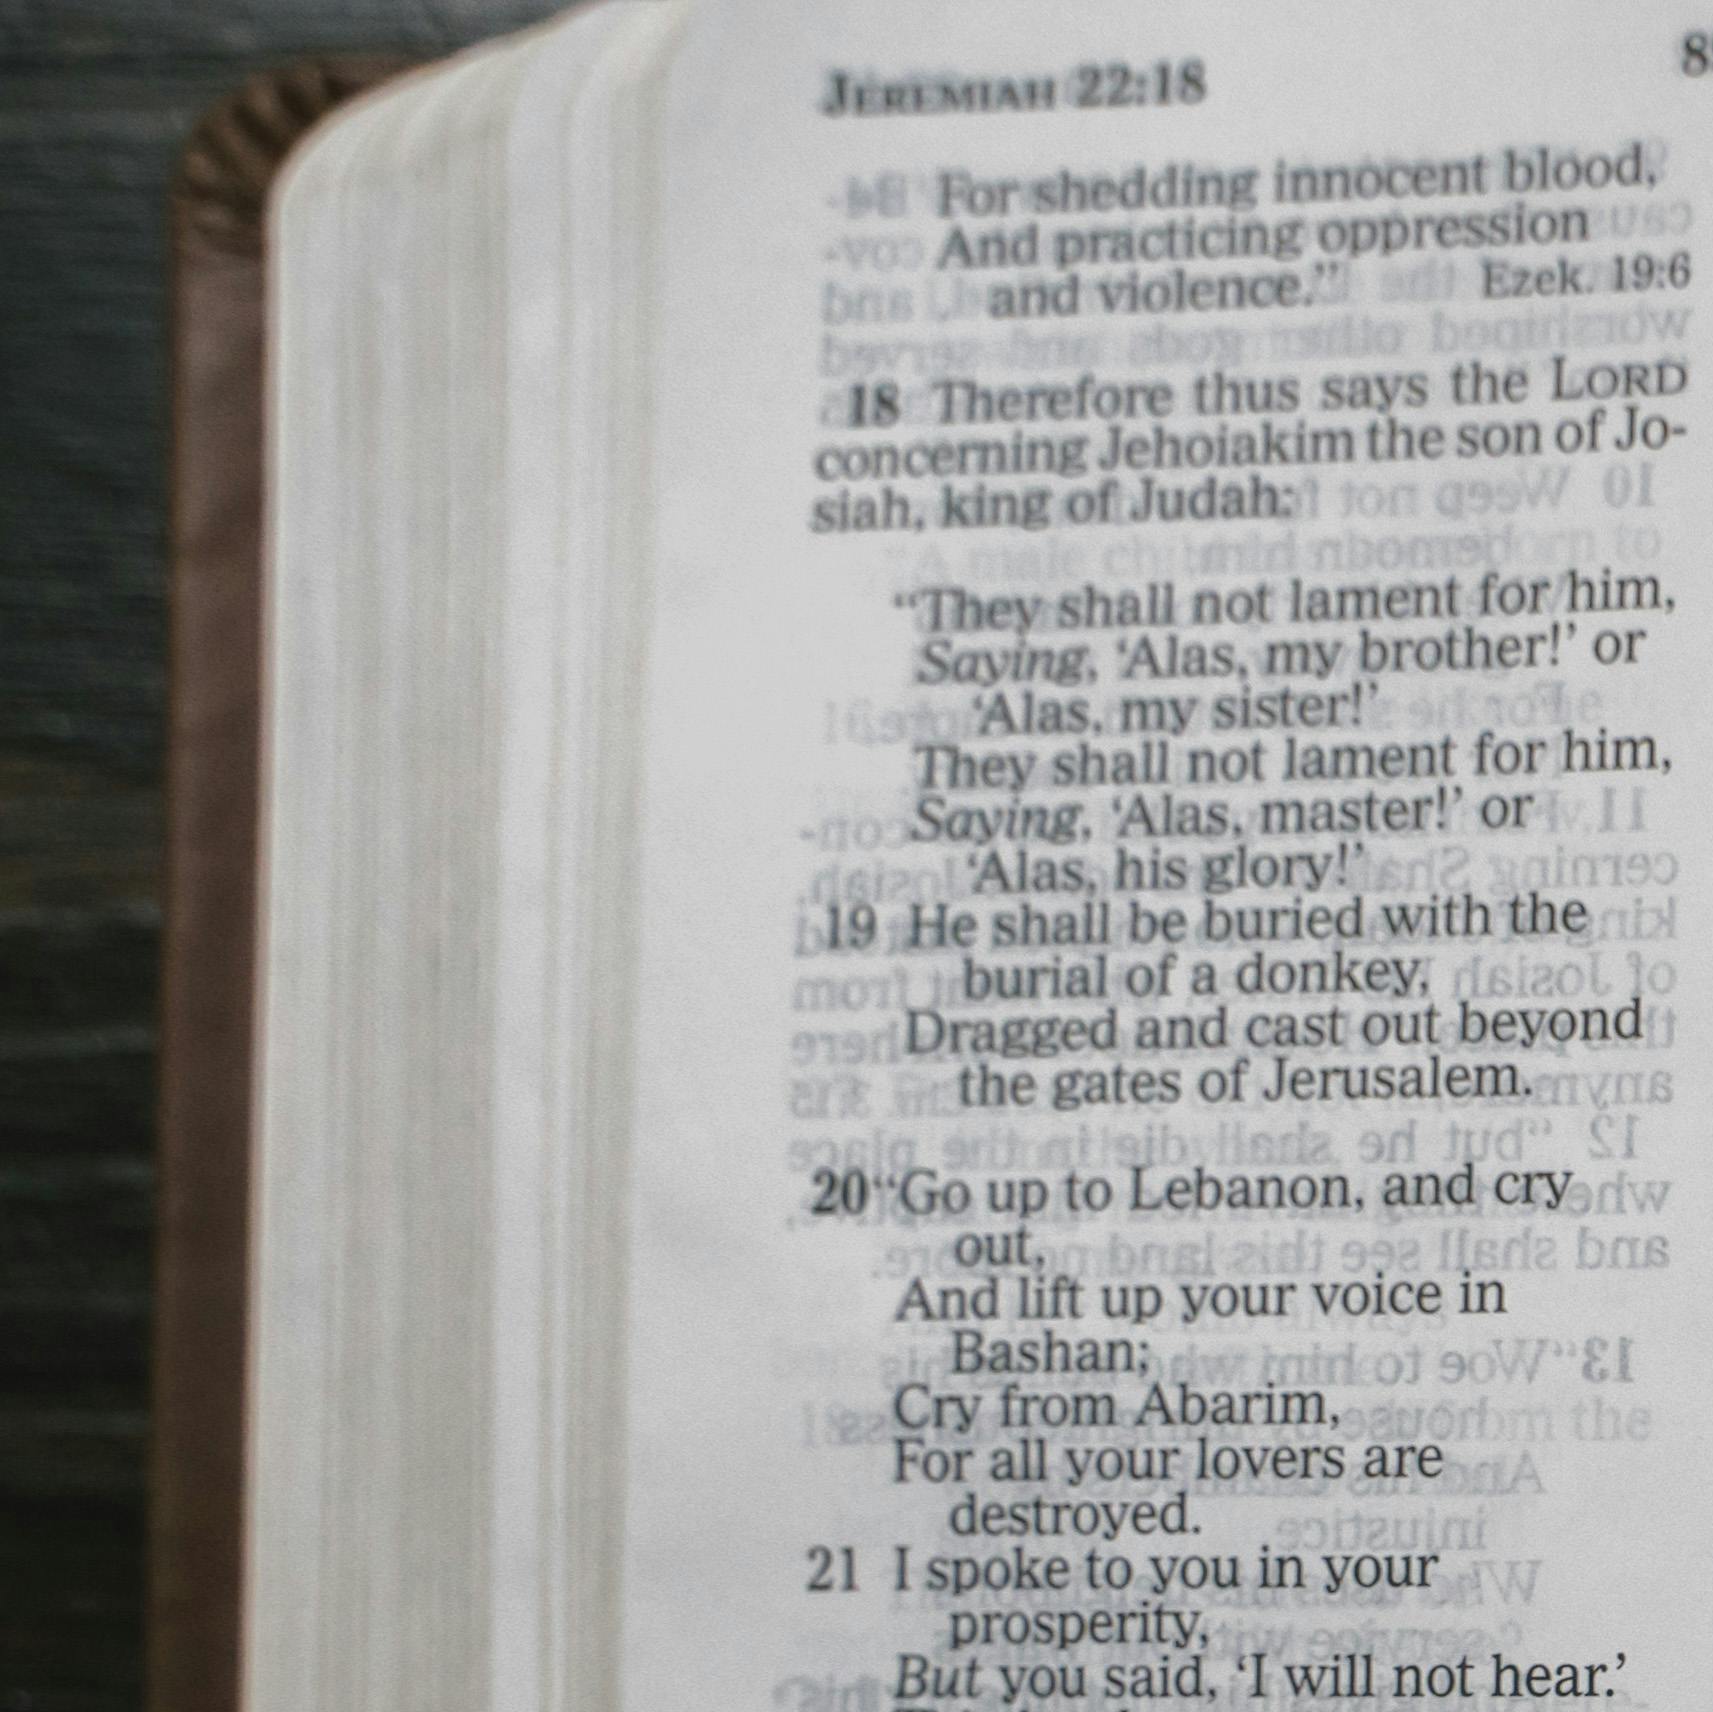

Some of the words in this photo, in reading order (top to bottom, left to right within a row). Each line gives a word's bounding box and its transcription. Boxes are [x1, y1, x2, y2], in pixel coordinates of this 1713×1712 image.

[821, 70, 1058, 116] JEREMIAH
[1073, 60, 1206, 109] 22:18
[1479, 258, 1596, 300] Ezek.
[1612, 253, 1691, 294] 19:6
[848, 385, 899, 427] 18
[939, 377, 1176, 424] Therefore
[1195, 373, 1301, 415] thus
[1319, 367, 1428, 415] says
[1451, 361, 1529, 404] the
[1551, 355, 1687, 400] LORD
[828, 905, 876, 950] 19
[909, 903, 978, 947] He
[993, 902, 1109, 946] shall
[1129, 901, 1188, 943] be
[1204, 896, 1363, 942] buried
[1381, 893, 1493, 939] with
[1508, 891, 1588, 936] the
[907, 1006, 1117, 1058] Dragged
[1135, 1005, 1229, 1050] and
[1245, 1010, 1342, 1048] cast
[1360, 1006, 1439, 1046] out
[1459, 996, 1645, 1050] beyond
